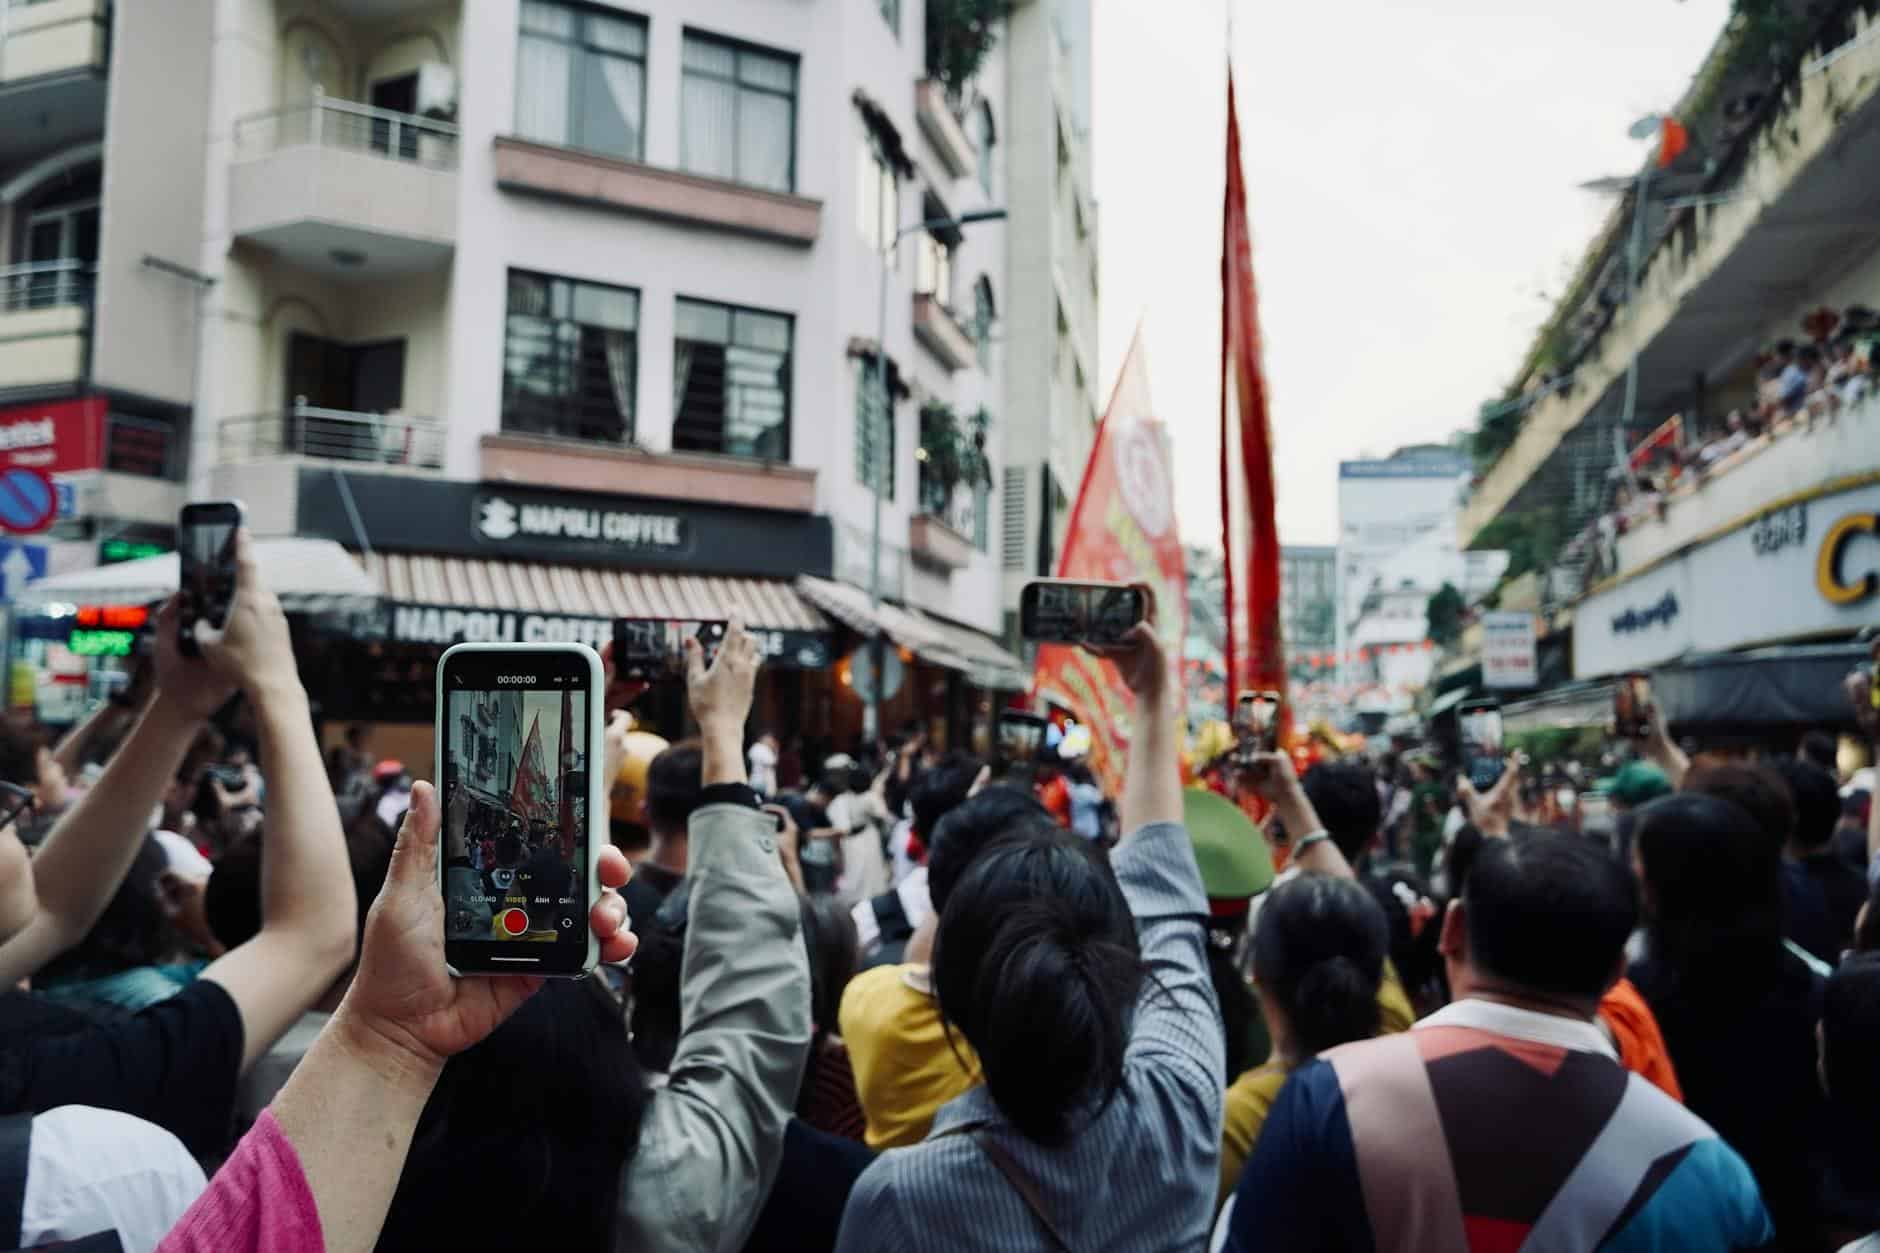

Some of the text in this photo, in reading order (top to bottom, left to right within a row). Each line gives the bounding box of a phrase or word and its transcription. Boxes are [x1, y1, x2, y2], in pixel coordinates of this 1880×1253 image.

[520, 504, 680, 546] NAPOLI COFFEE
[394, 606, 516, 644] NAPOLI
[523, 615, 613, 650] COFFE
[497, 675, 537, 684] 00:00:00
[505, 895, 528, 904] VIDEO
